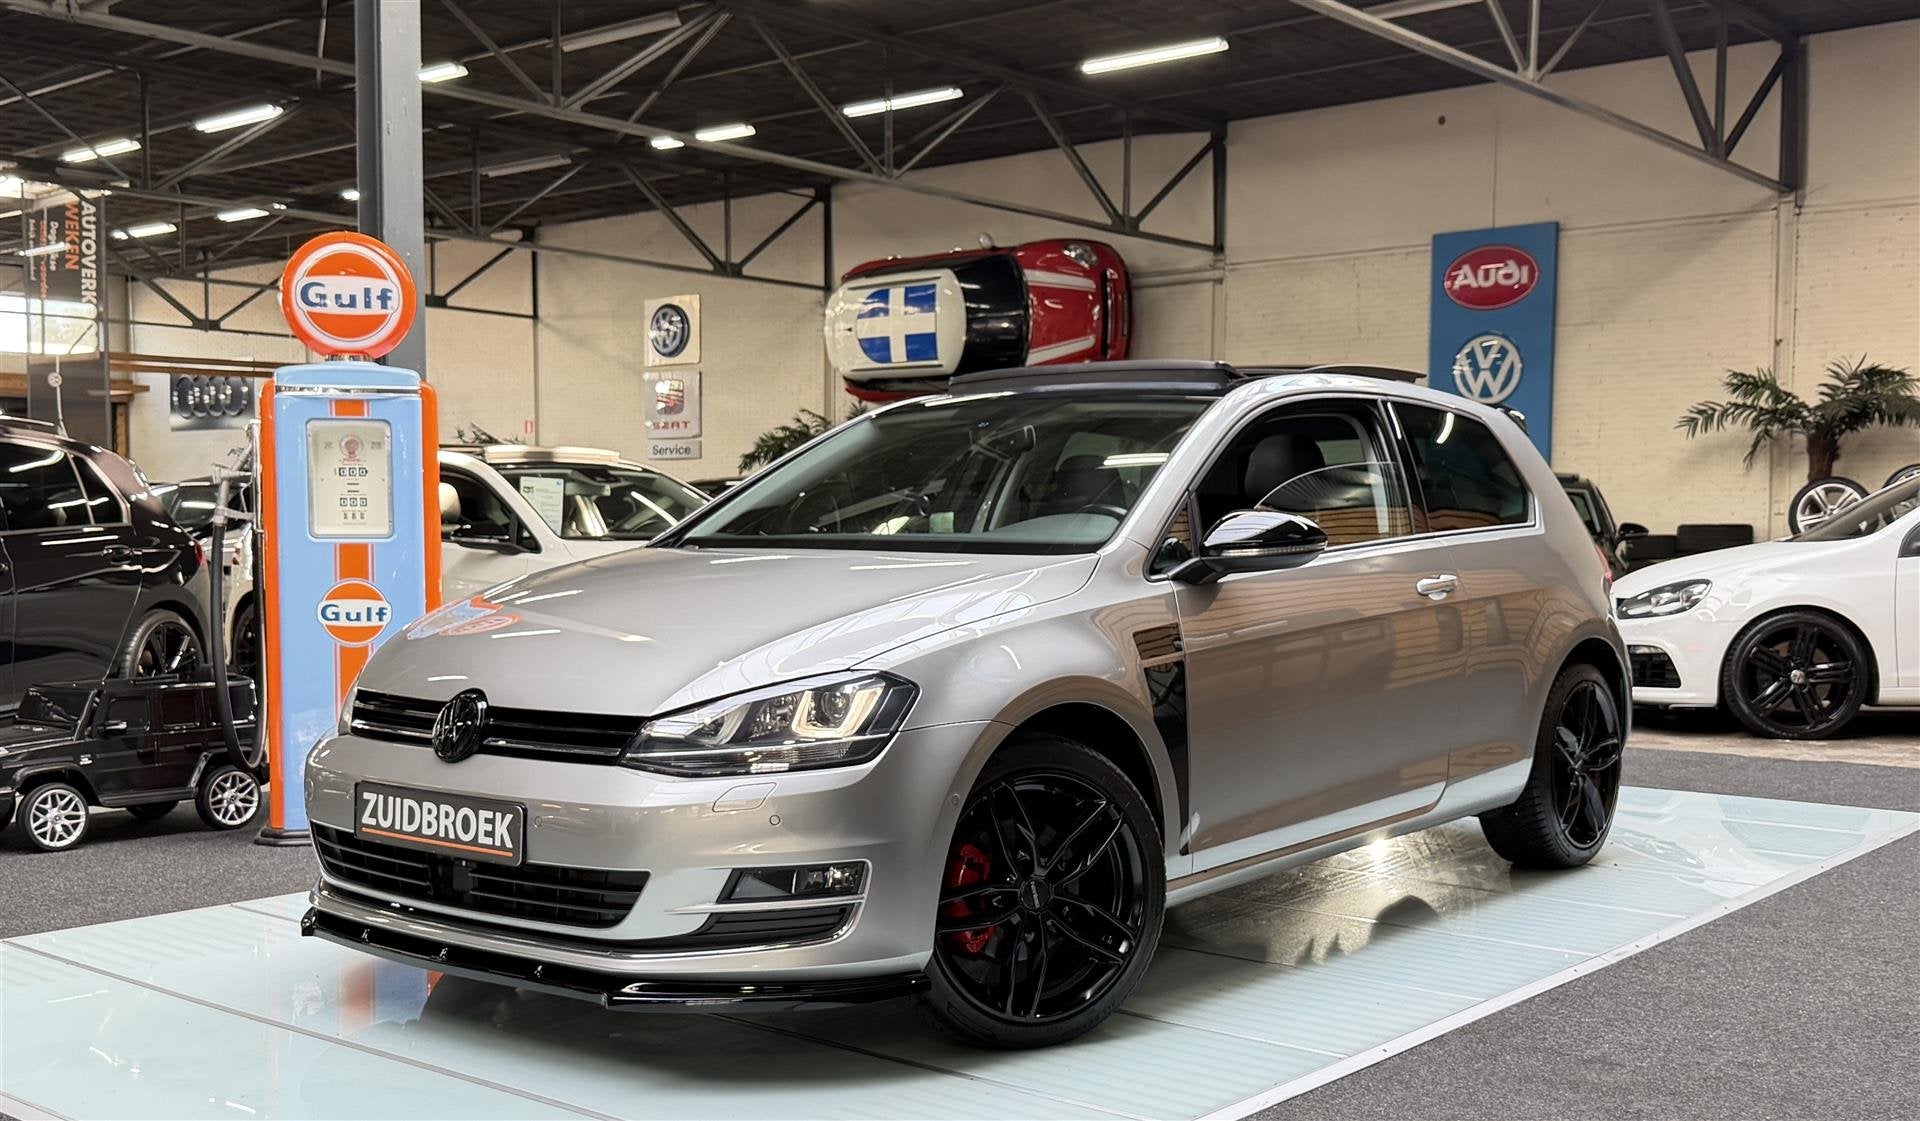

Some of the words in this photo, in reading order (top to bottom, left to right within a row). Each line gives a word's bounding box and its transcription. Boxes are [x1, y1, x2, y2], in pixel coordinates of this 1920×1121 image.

[65, 202, 80, 270] WEKEN
[300, 281, 393, 310] Gulf
[652, 443, 691, 456] Service
[321, 604, 388, 622] Gulf
[361, 791, 514, 848] ZUIDBROEK
